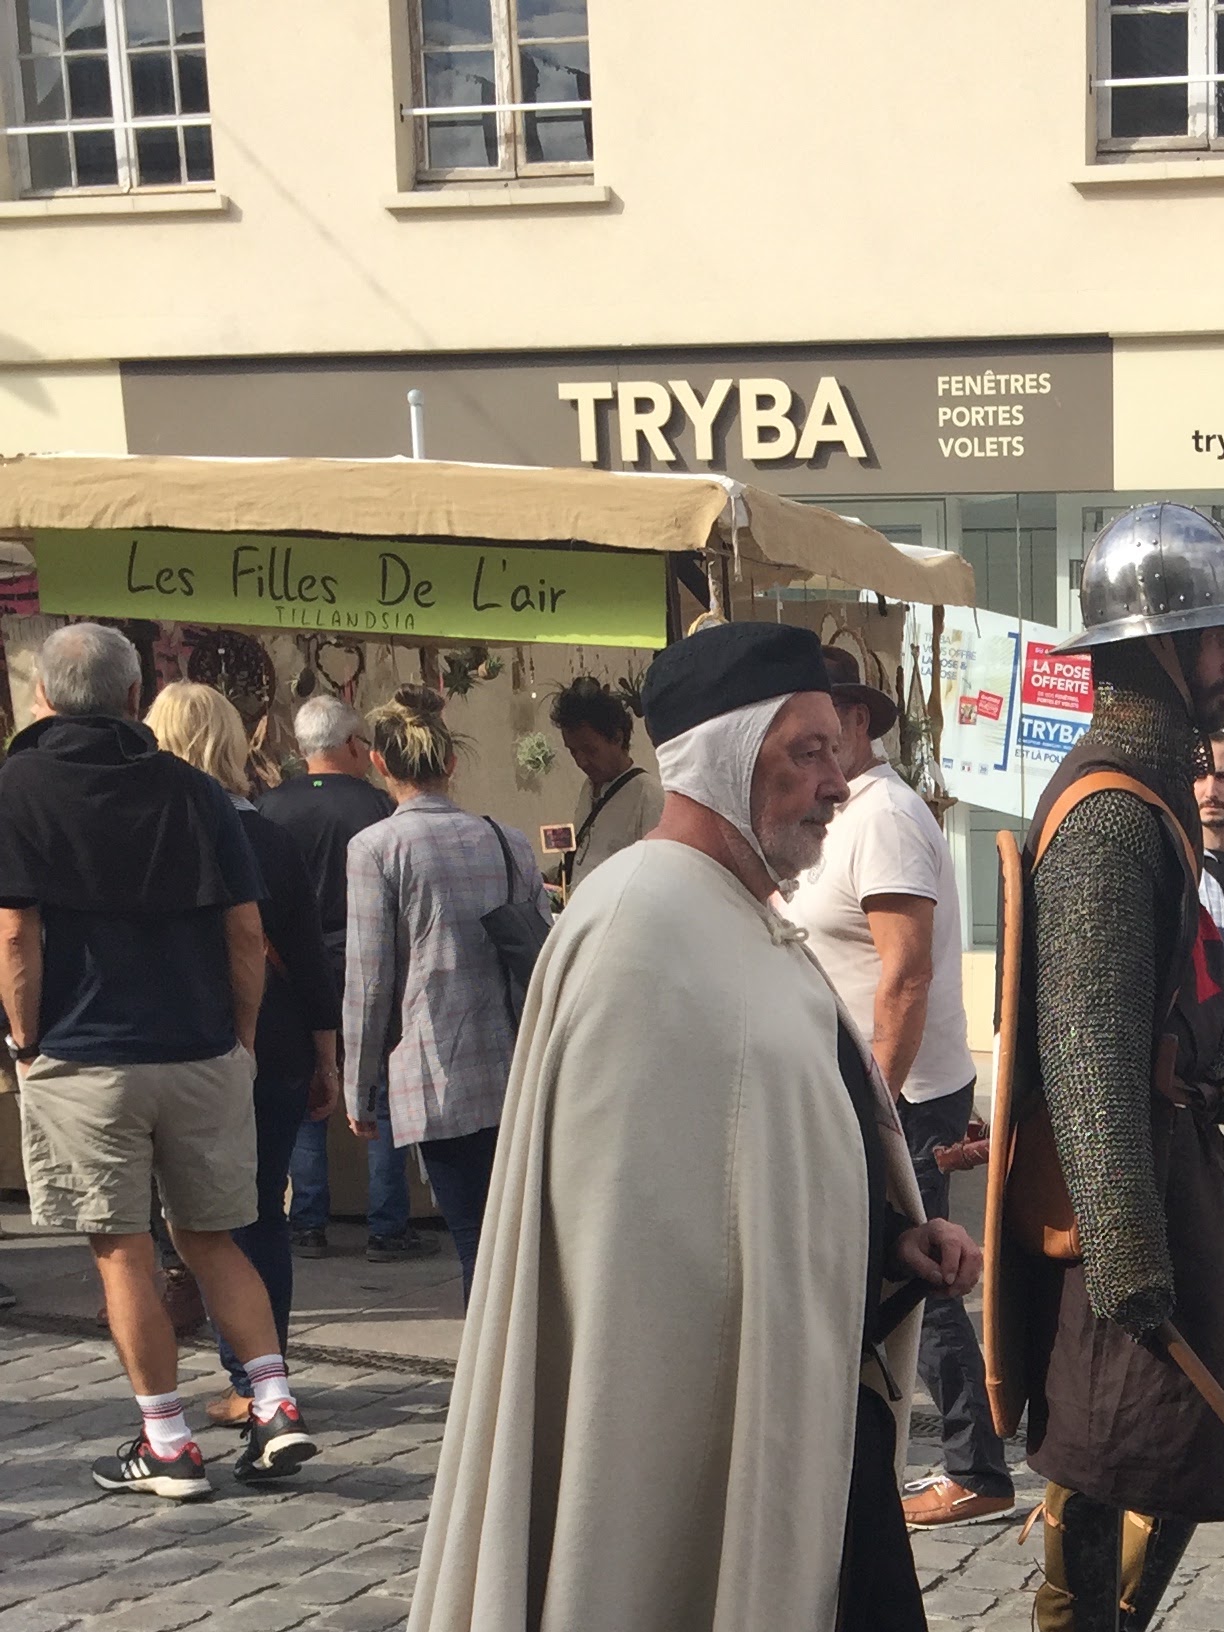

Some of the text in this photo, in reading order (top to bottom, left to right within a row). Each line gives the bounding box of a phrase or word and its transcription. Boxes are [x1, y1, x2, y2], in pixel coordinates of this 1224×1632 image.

[937, 370, 1052, 396] FENÊTRES
[558, 376, 867, 462] TRYBA
[937, 405, 1025, 427] PORTES
[938, 436, 1025, 458] VOLETS
[126, 540, 567, 613] Les Filles De L'air
[276, 605, 415, 630] TILLANDSIA
[1033, 660, 1091, 680] LA POSE
[1030, 675, 1090, 695] OFFERTE
[1021, 717, 1086, 745] TRYBA
